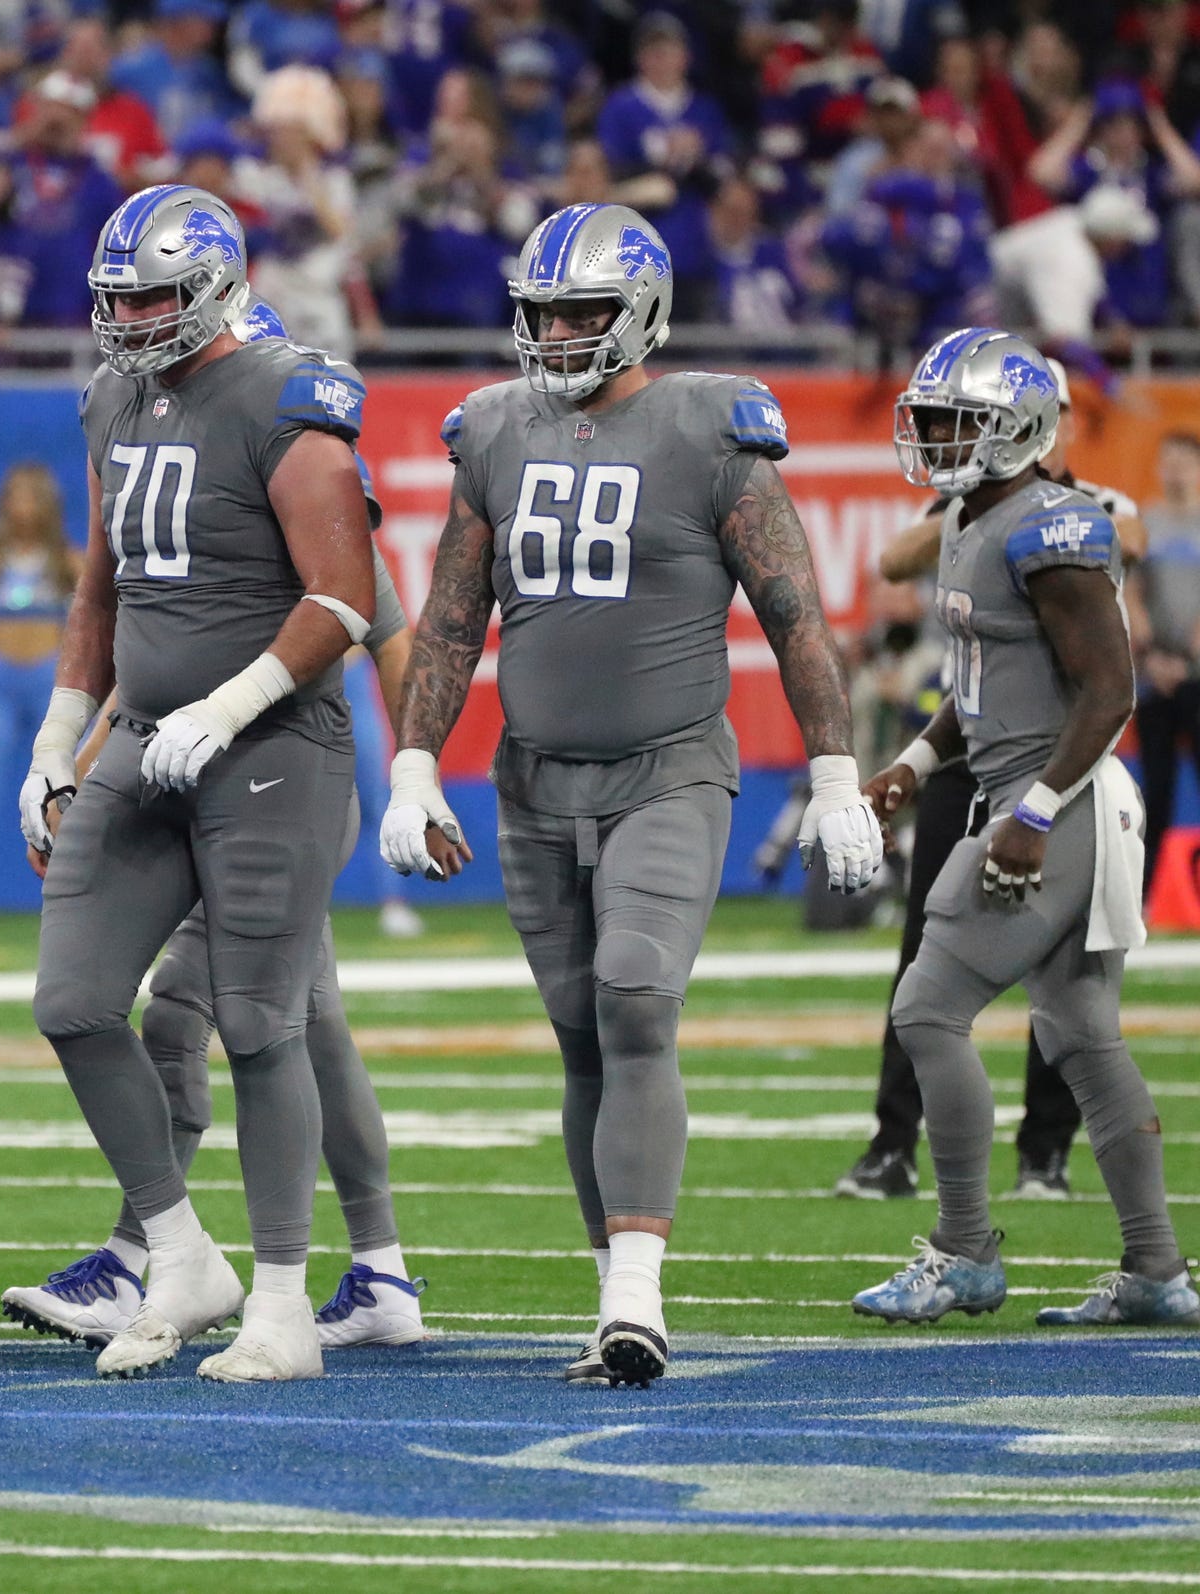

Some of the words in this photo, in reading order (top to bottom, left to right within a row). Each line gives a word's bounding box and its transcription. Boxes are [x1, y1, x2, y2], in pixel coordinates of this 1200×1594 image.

[313, 380, 359, 412] WCF
[110, 441, 196, 579] 70
[508, 459, 640, 600] 68
[1040, 520, 1093, 546] WCF
[936, 587, 982, 717] 0
